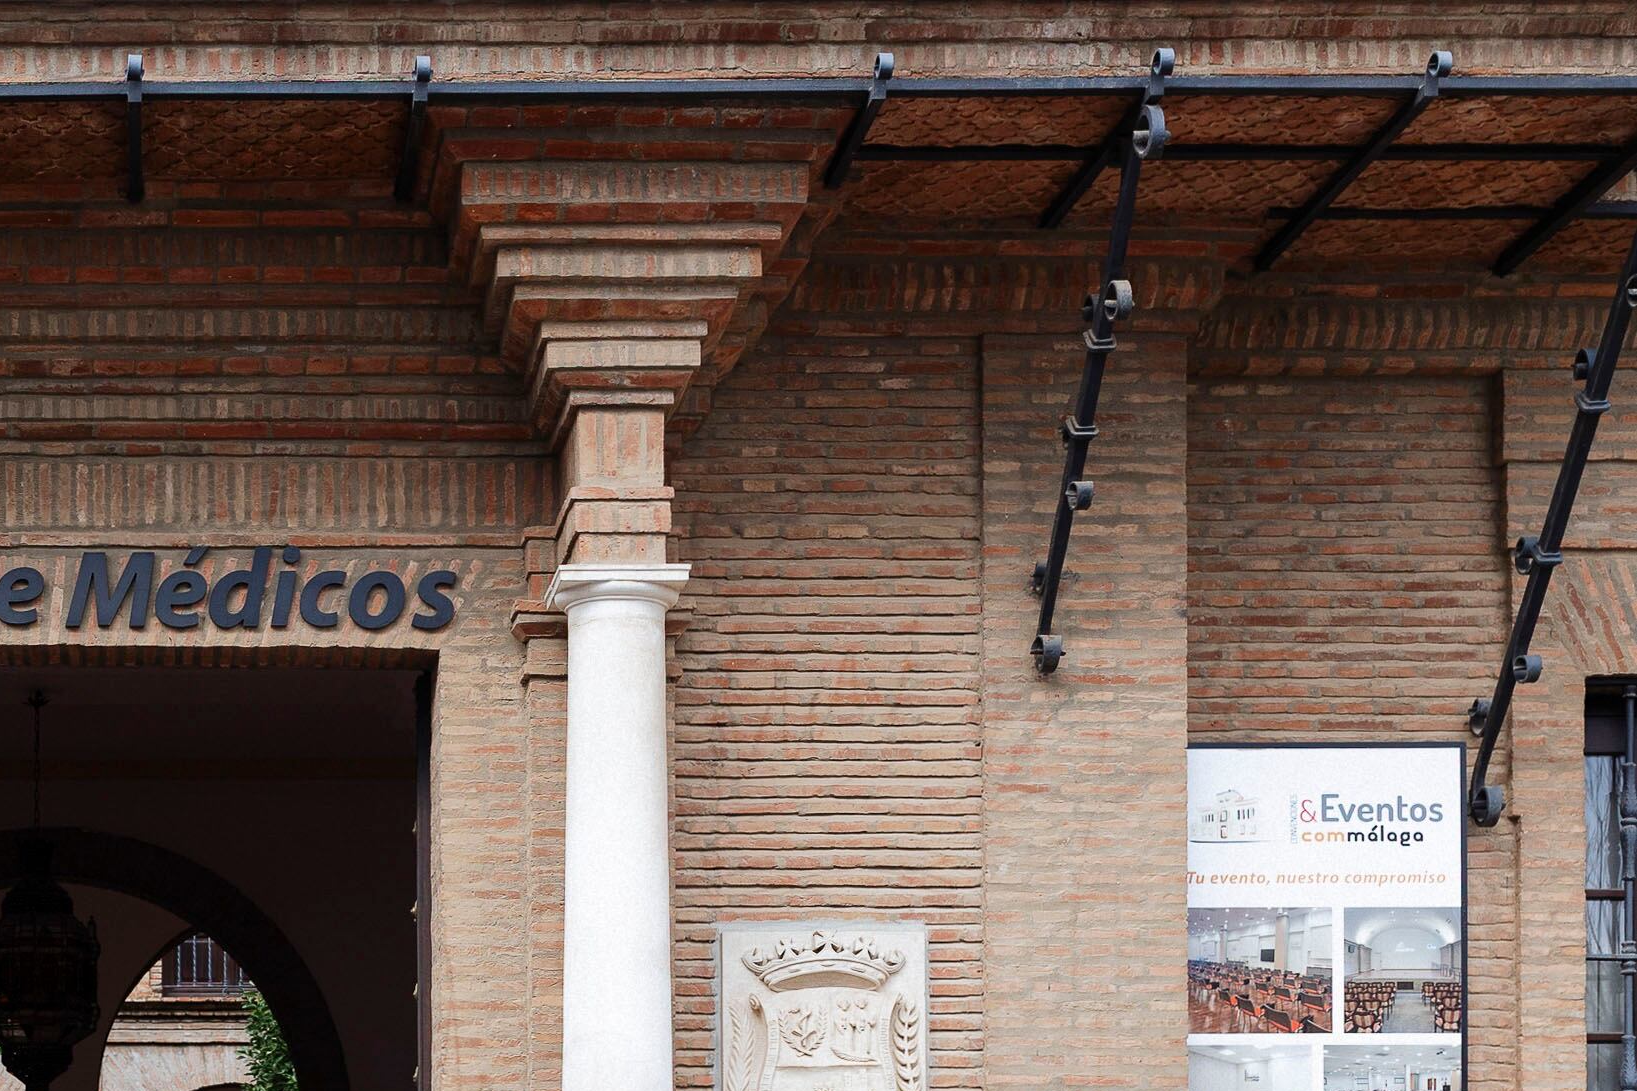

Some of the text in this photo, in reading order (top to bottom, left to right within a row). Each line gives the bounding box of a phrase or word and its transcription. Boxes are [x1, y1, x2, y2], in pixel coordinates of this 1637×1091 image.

[66, 546, 455, 629] Médicos
[1321, 794, 1443, 823] Eventos
[1301, 825, 1424, 846] commálaga
[1186, 870, 1446, 888] Tu evento, nuestro compromiso
